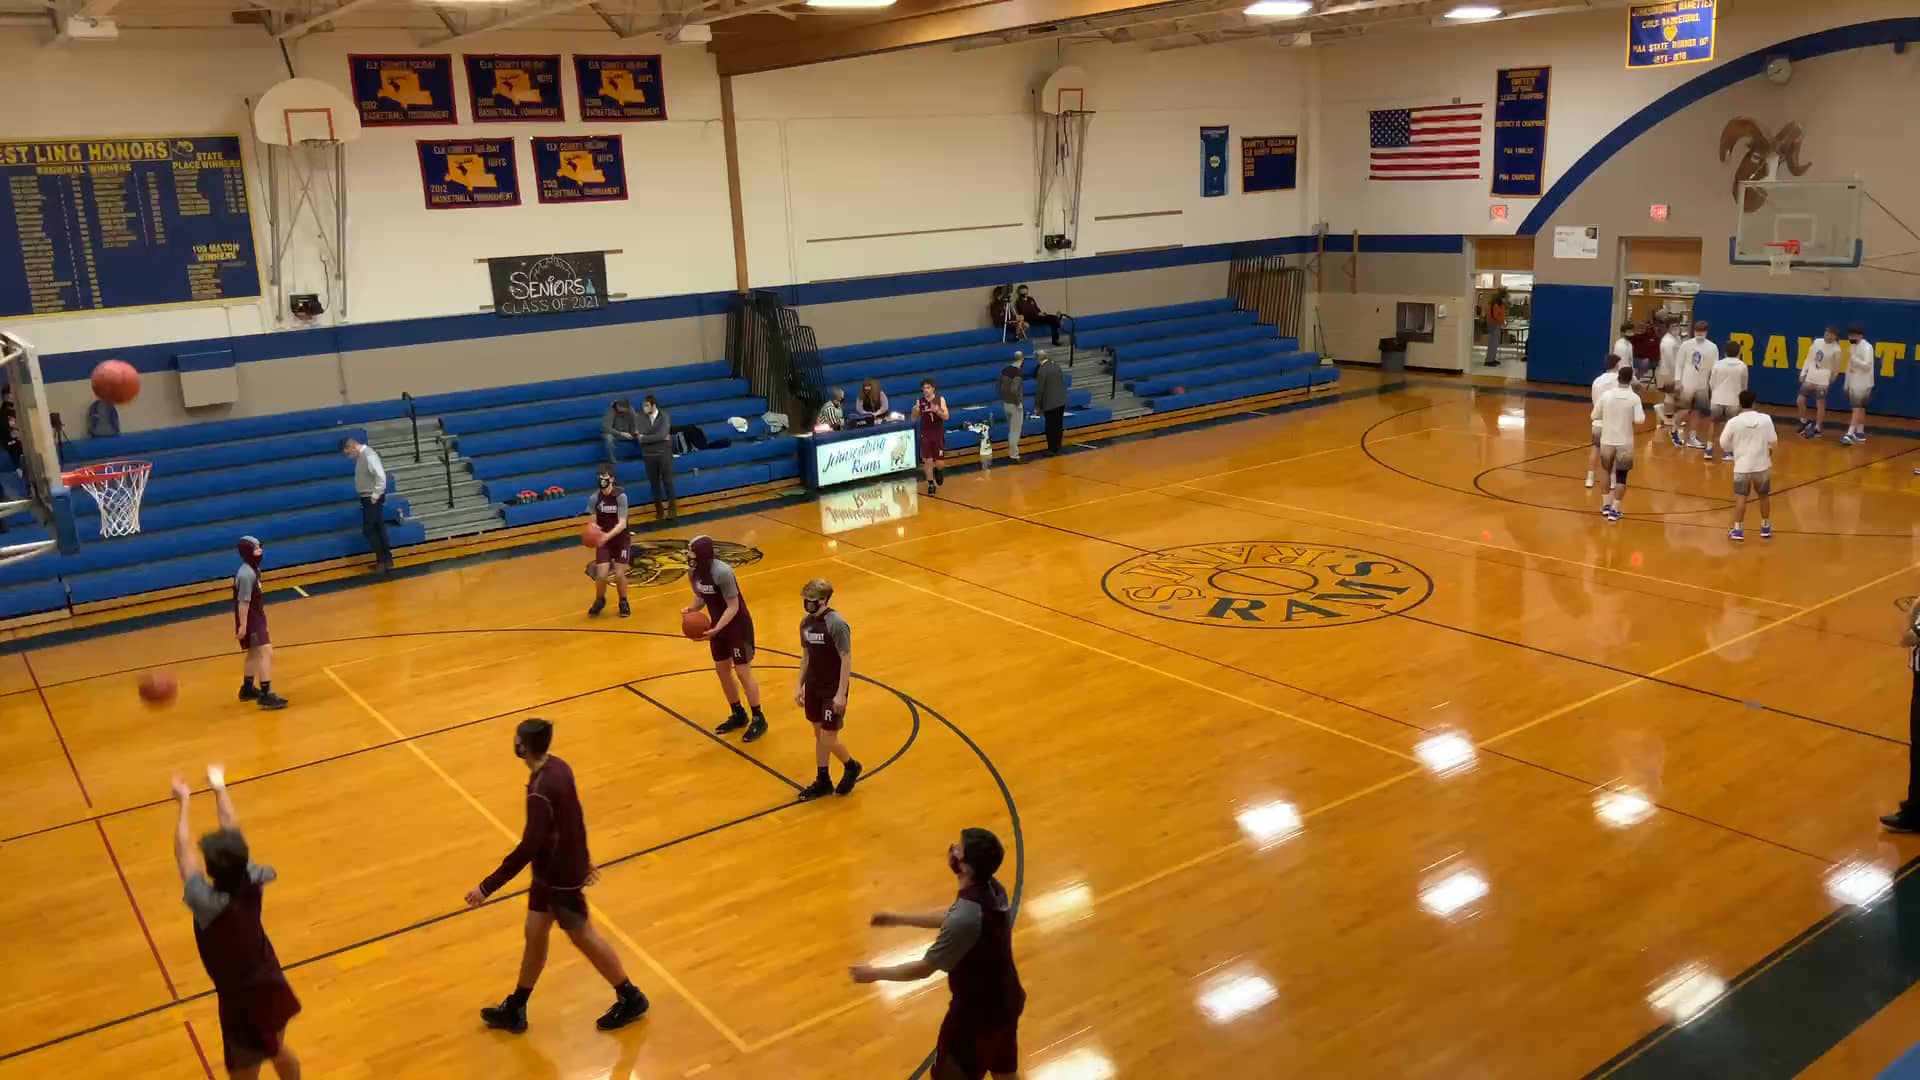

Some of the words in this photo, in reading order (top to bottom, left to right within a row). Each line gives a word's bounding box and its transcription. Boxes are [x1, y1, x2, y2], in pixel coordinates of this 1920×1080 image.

[88, 141, 169, 161] HONORS
[196, 151, 224, 161] STATE
[502, 299, 549, 315] CLASS
[551, 297, 570, 312] OF
[572, 295, 600, 310] 2021
[851, 458, 881, 474] Rams
[1193, 560, 1412, 624] RAMS
[733, 647, 742, 658] R
[824, 709, 833, 722] R
